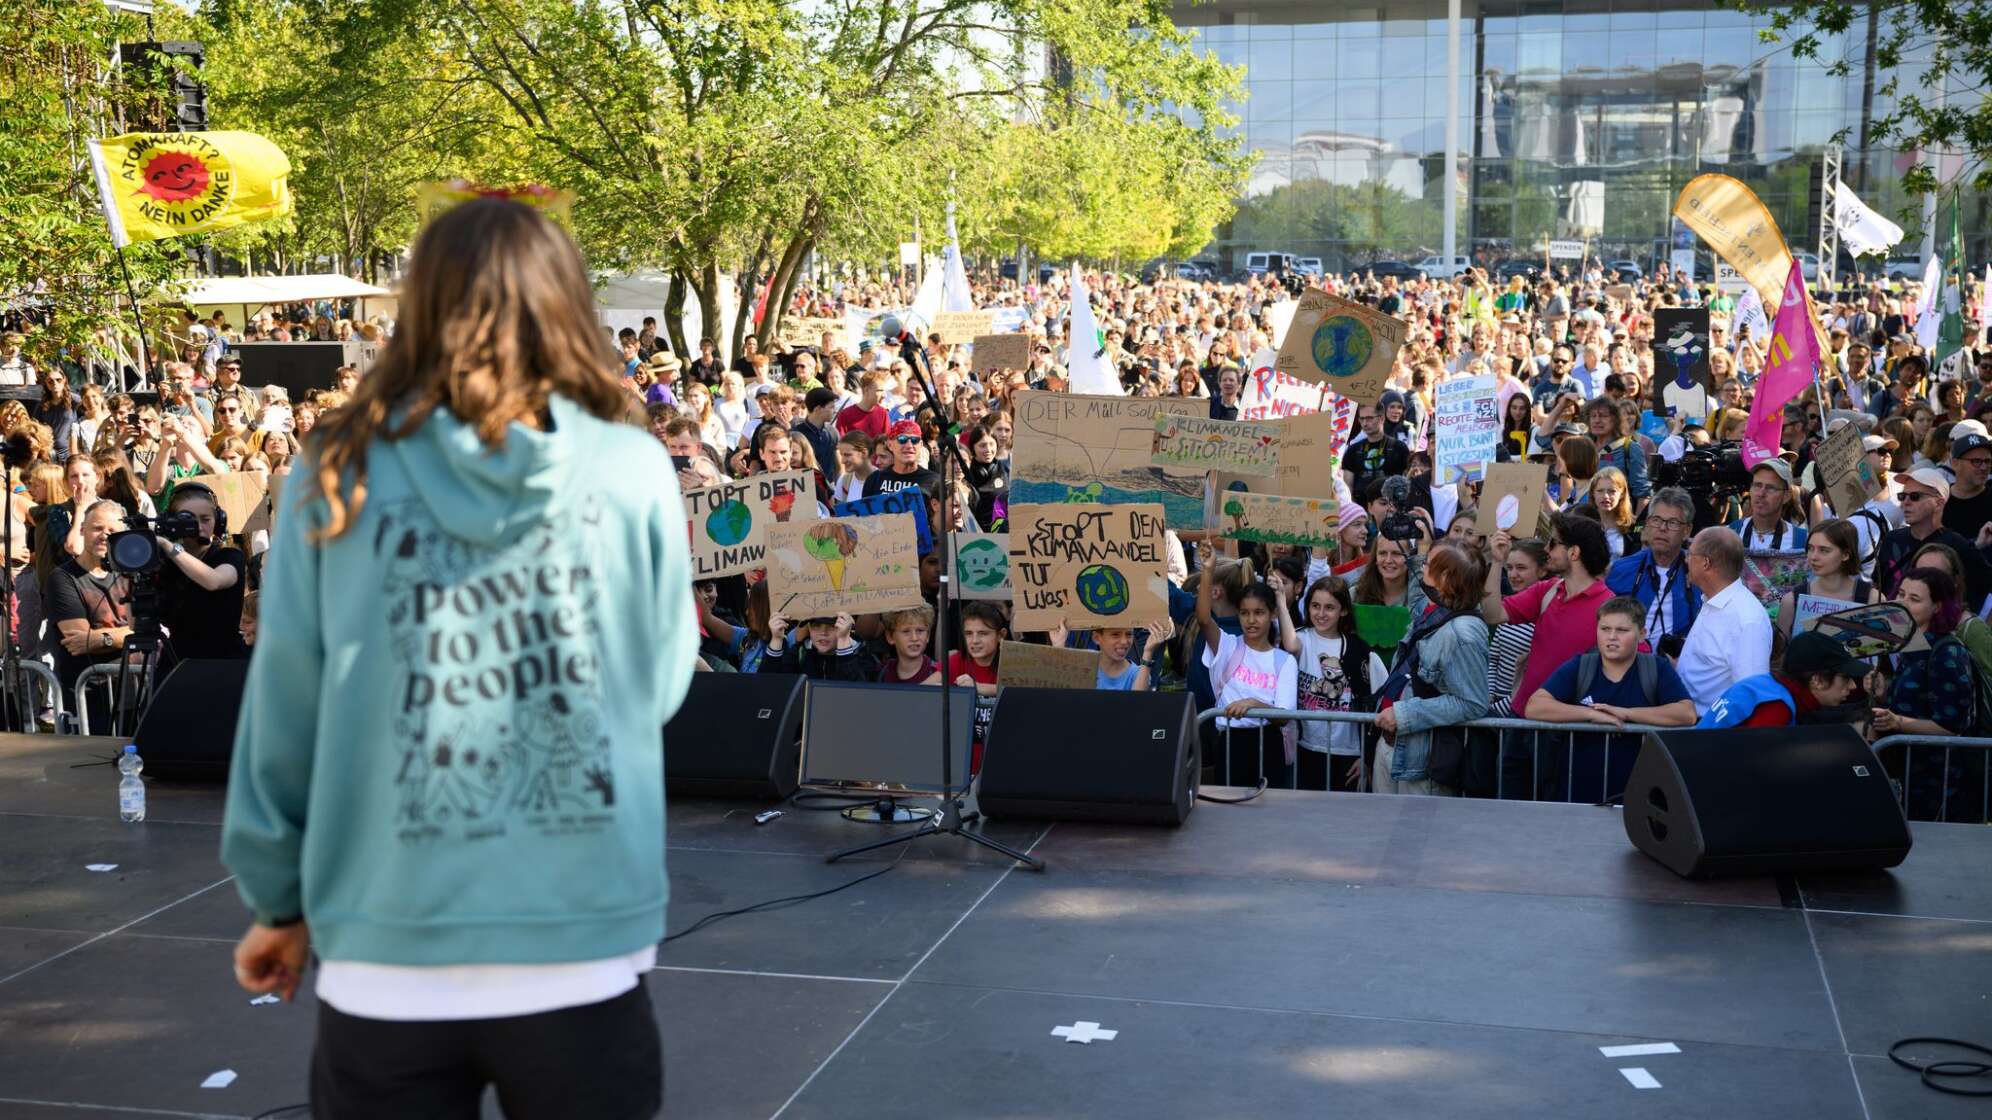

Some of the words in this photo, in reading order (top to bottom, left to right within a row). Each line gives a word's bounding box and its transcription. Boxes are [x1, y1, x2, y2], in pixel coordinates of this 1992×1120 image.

[122, 133, 219, 181] ATOMKRAFT?
[139, 201, 186, 225] NEIN
[191, 171, 229, 222] DANKE
[1026, 400, 1075, 421] DER
[682, 485, 751, 515] TOPT
[759, 477, 806, 501] DEN
[879, 479, 919, 492] ALOH
[1034, 511, 1113, 542] STOPT
[1129, 511, 1165, 540] DEN
[1018, 562, 1051, 586] TUT
[427, 628, 479, 665] to
[492, 603, 577, 654] the
[403, 645, 592, 713] people
